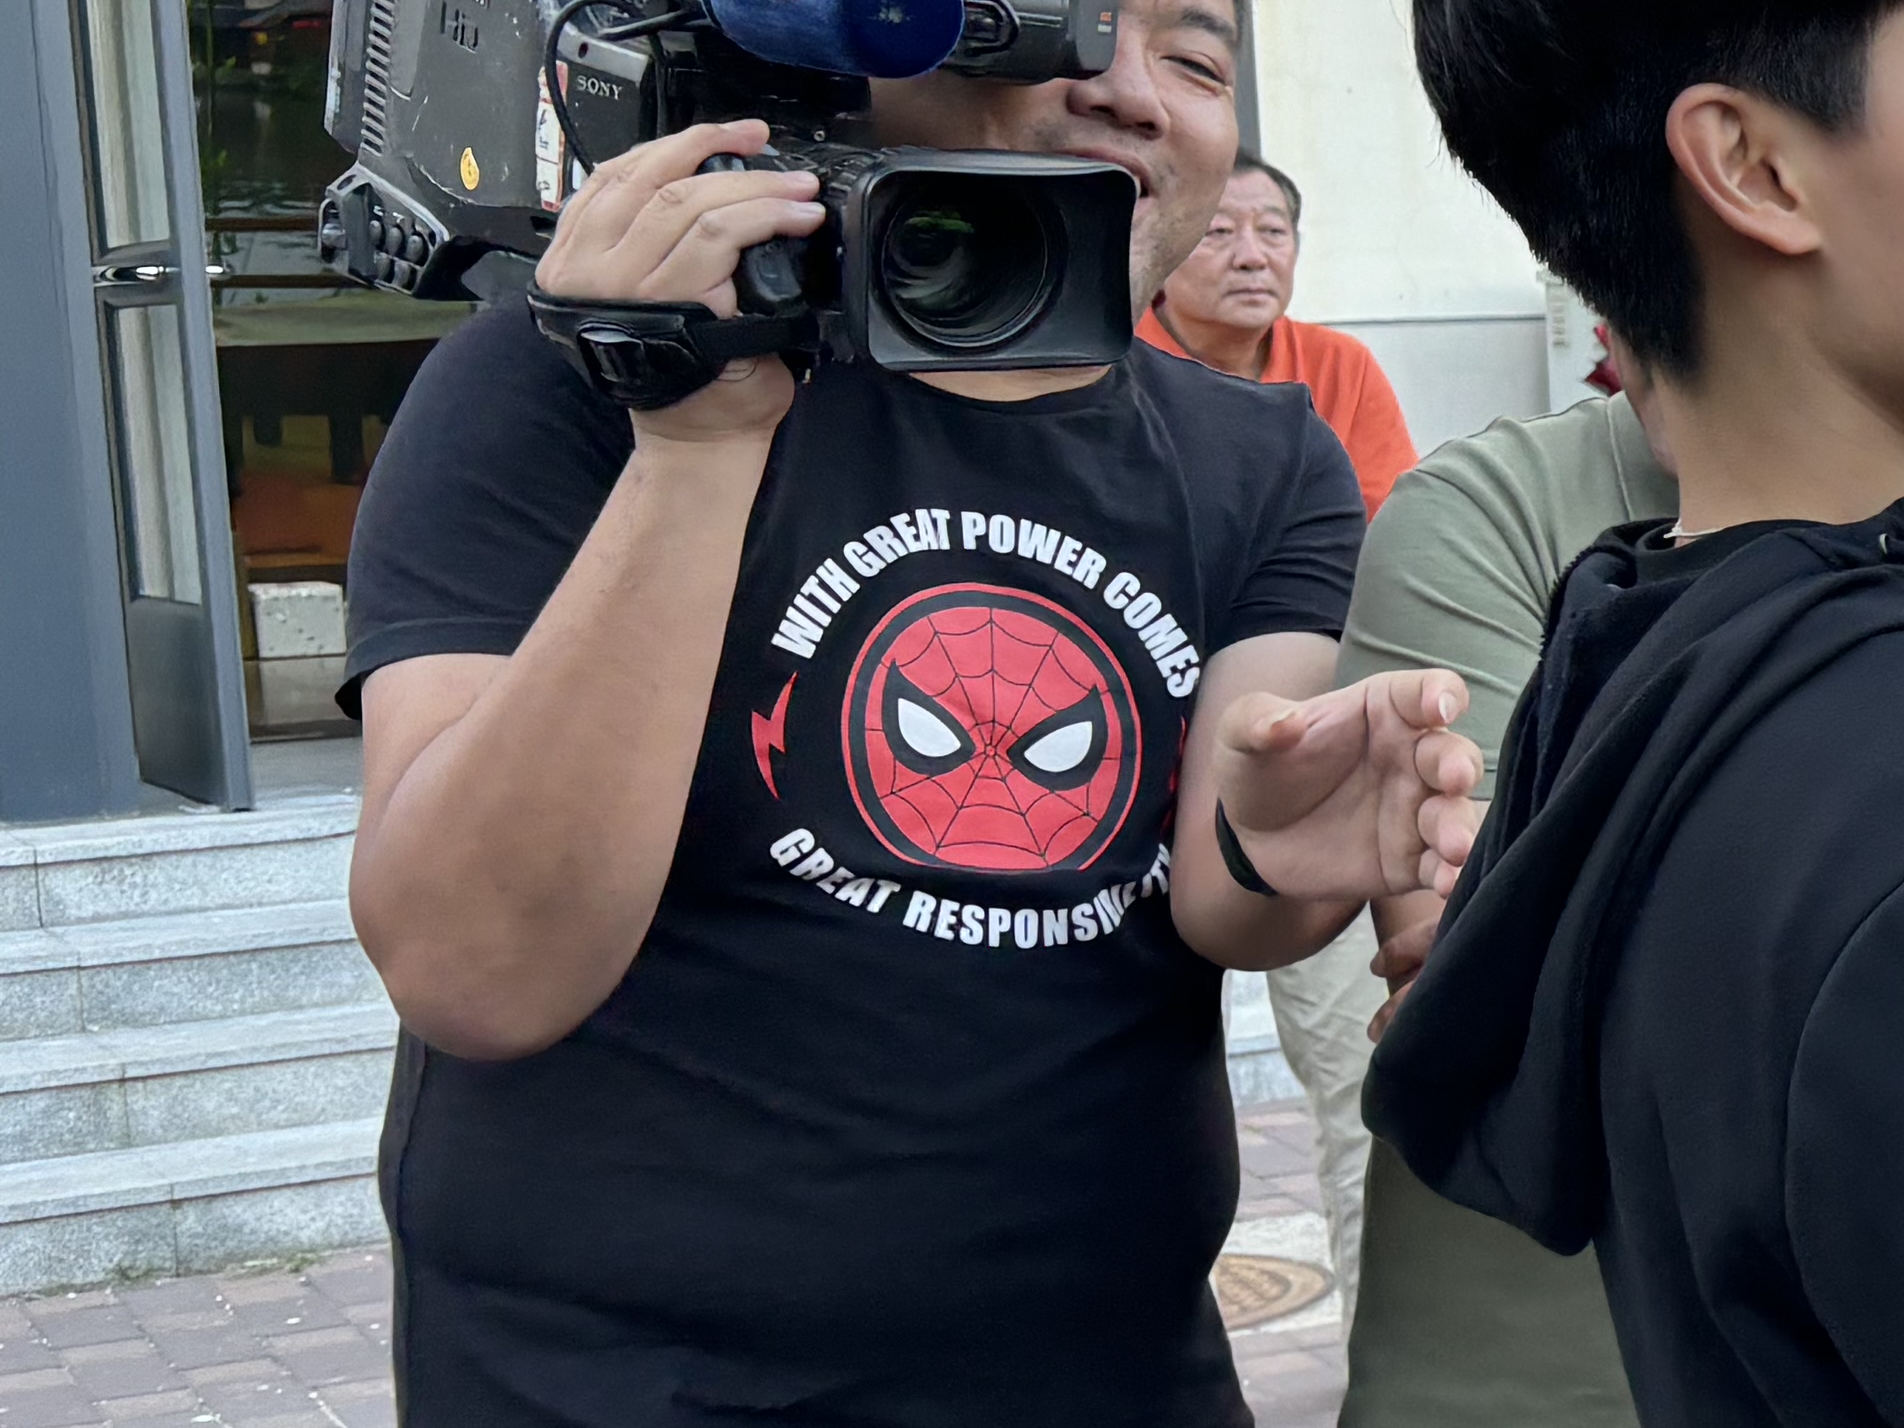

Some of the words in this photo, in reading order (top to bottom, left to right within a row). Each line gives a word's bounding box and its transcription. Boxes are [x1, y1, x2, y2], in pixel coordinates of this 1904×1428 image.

[575, 74, 623, 101] SONY
[771, 557, 861, 661] WITH
[842, 508, 951, 579] GREAT
[961, 510, 1108, 590] POWER
[1102, 571, 1202, 699] COMES
[769, 827, 902, 915] GREAT
